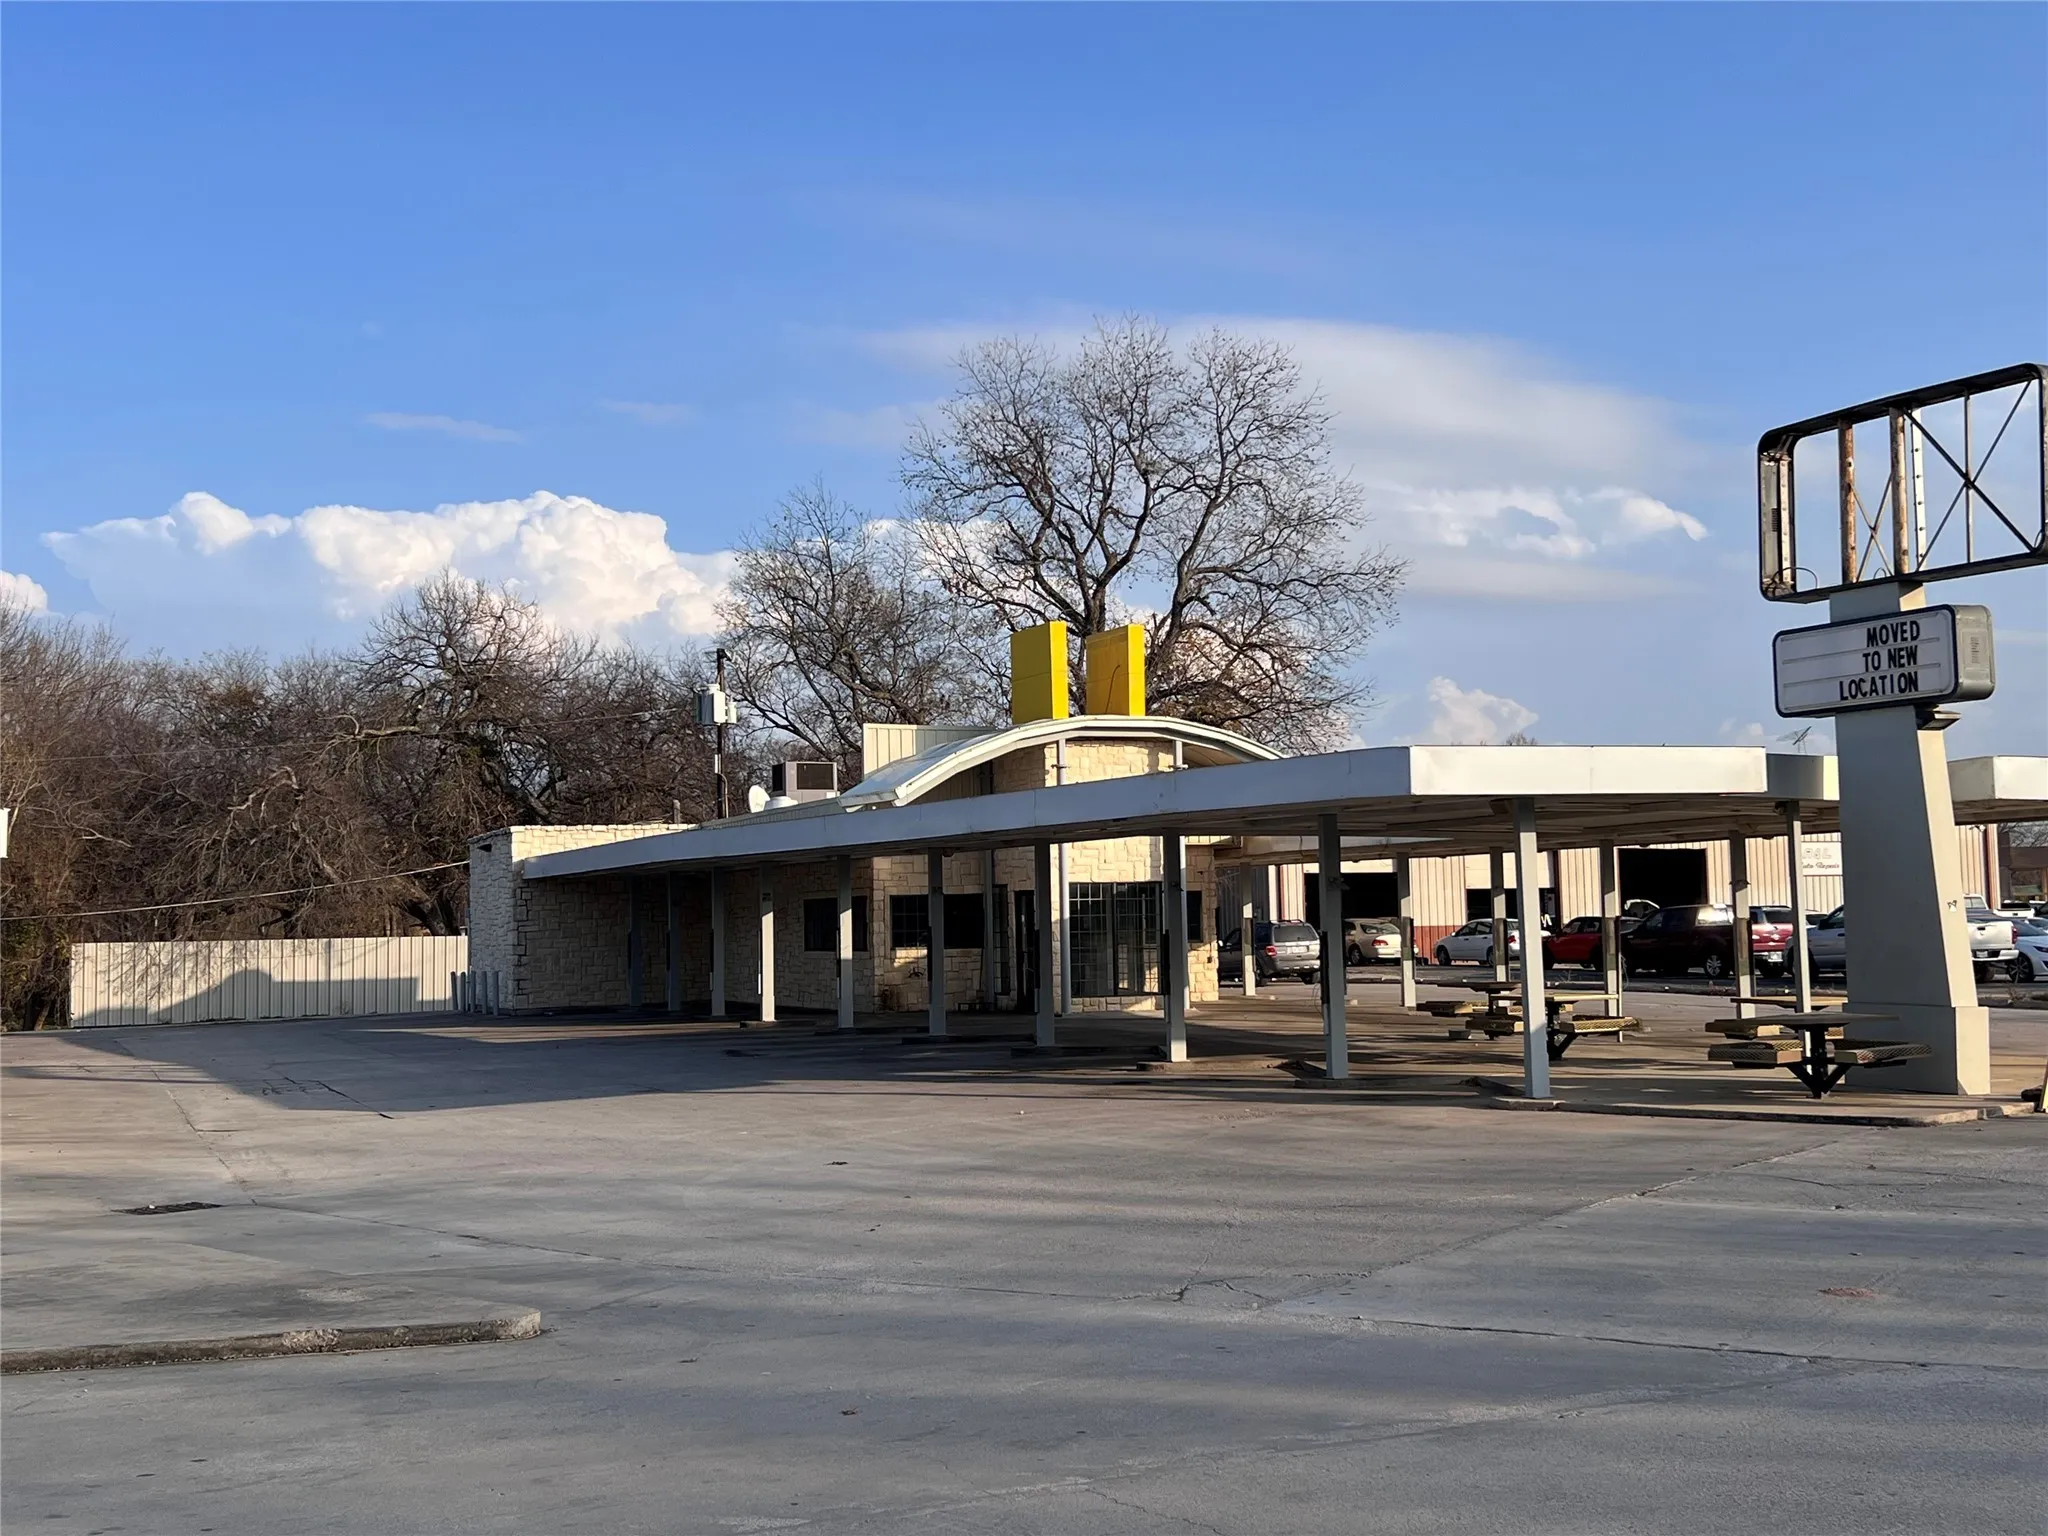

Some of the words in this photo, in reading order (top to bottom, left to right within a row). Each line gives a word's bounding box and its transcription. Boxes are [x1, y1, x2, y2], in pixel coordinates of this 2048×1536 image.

[1866, 620, 1920, 648] MOVED
[1862, 652, 1881, 673] TO
[1888, 645, 1918, 669] NEW
[1839, 671, 1919, 701] LOCATION
